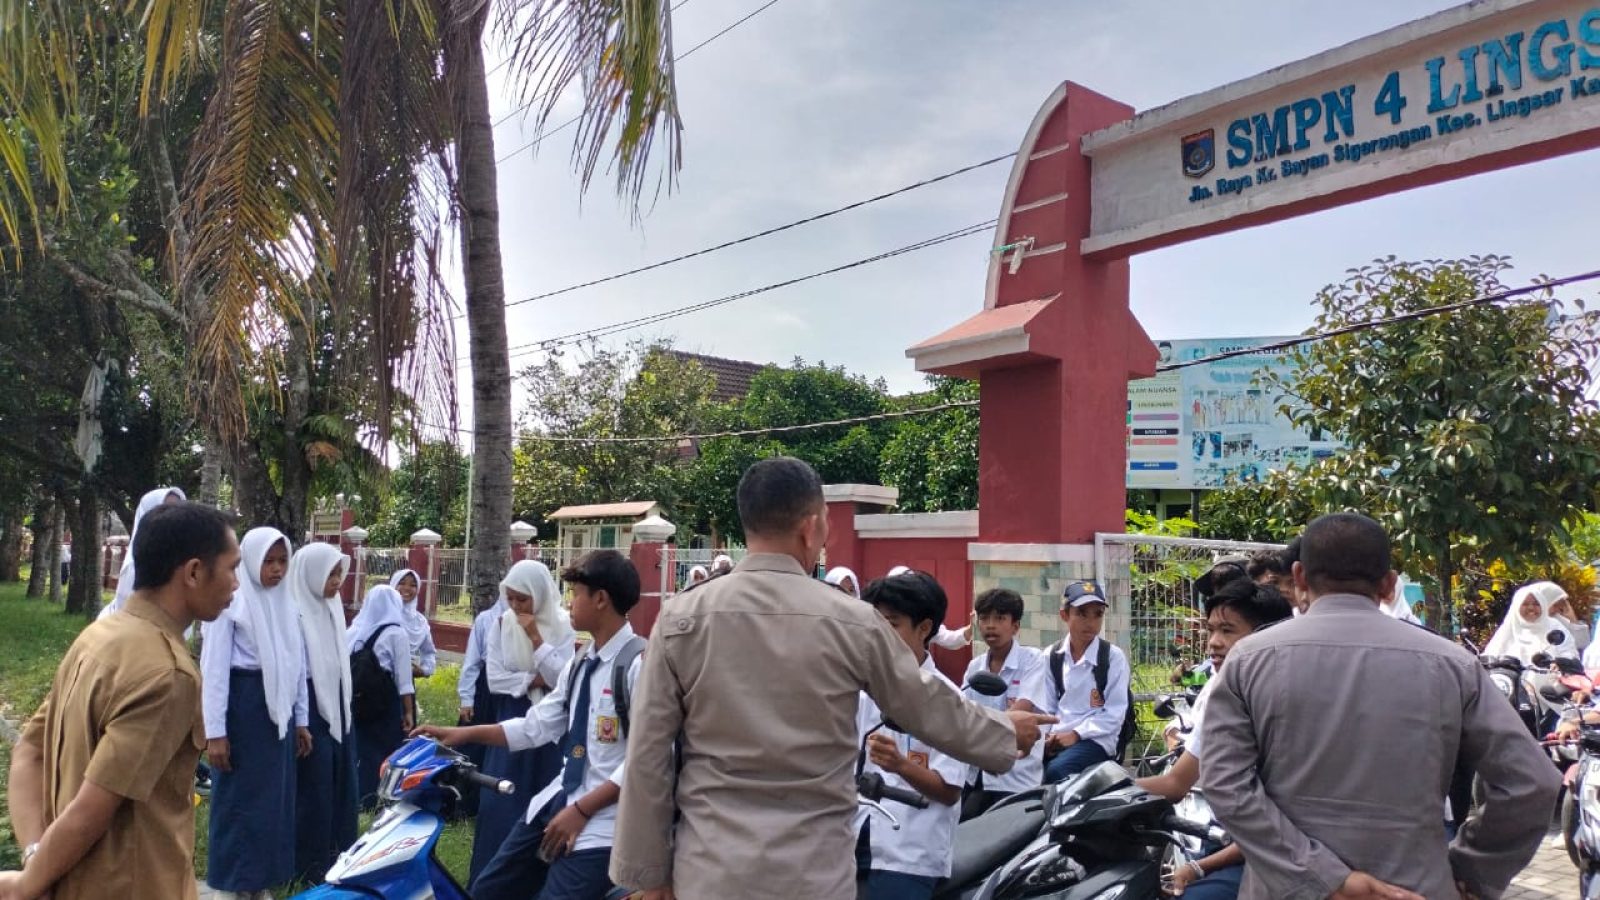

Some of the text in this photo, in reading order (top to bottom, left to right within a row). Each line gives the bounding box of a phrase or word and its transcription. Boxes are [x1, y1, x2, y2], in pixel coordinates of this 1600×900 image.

[1188, 185, 1213, 203] Jln.
[1216, 174, 1252, 195] Raya
[1256, 166, 1278, 185] Kr.
[1281, 154, 1330, 177] Bayan
[1436, 112, 1482, 136] Kec.
[1486, 87, 1564, 122] Lingsar
[1226, 84, 1356, 169] SMPN
[1374, 70, 1407, 125] 4
